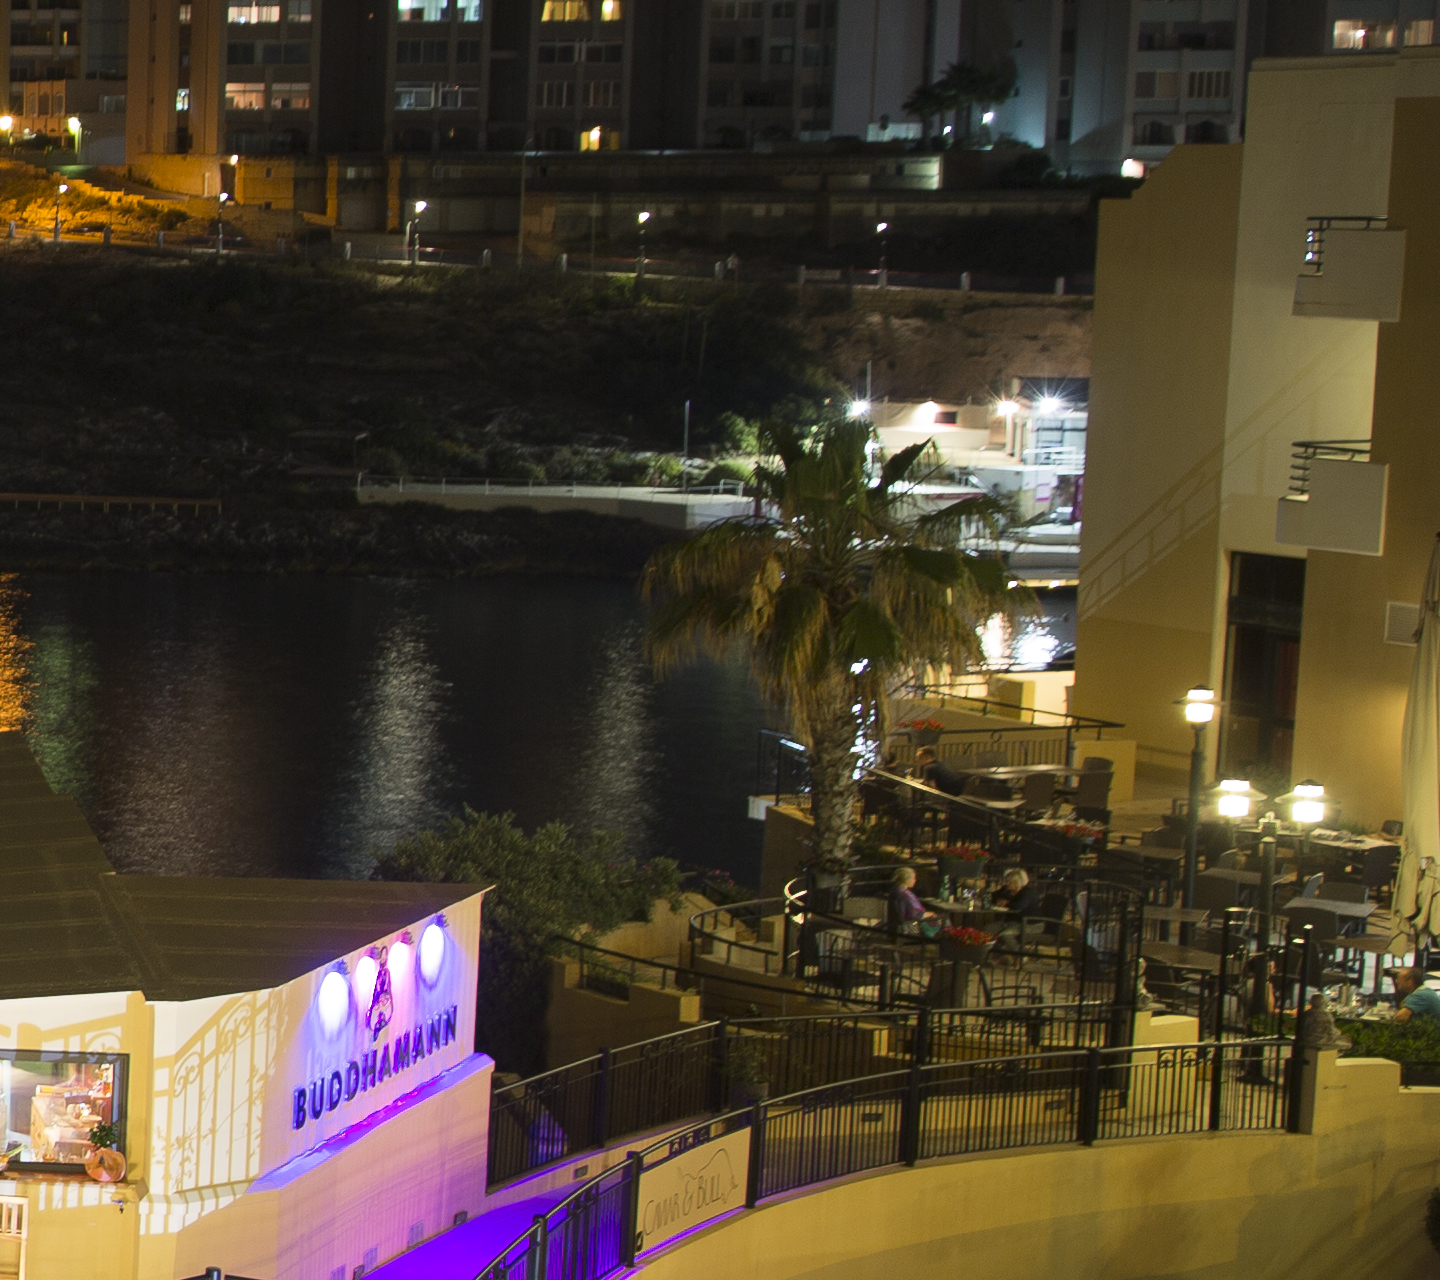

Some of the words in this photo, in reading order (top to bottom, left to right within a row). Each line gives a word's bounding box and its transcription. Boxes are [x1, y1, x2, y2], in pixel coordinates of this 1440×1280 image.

[292, 1004, 459, 1131] BUDDHAMANN
[682, 1180, 695, 1217] &
[696, 1174, 722, 1210] BULL
